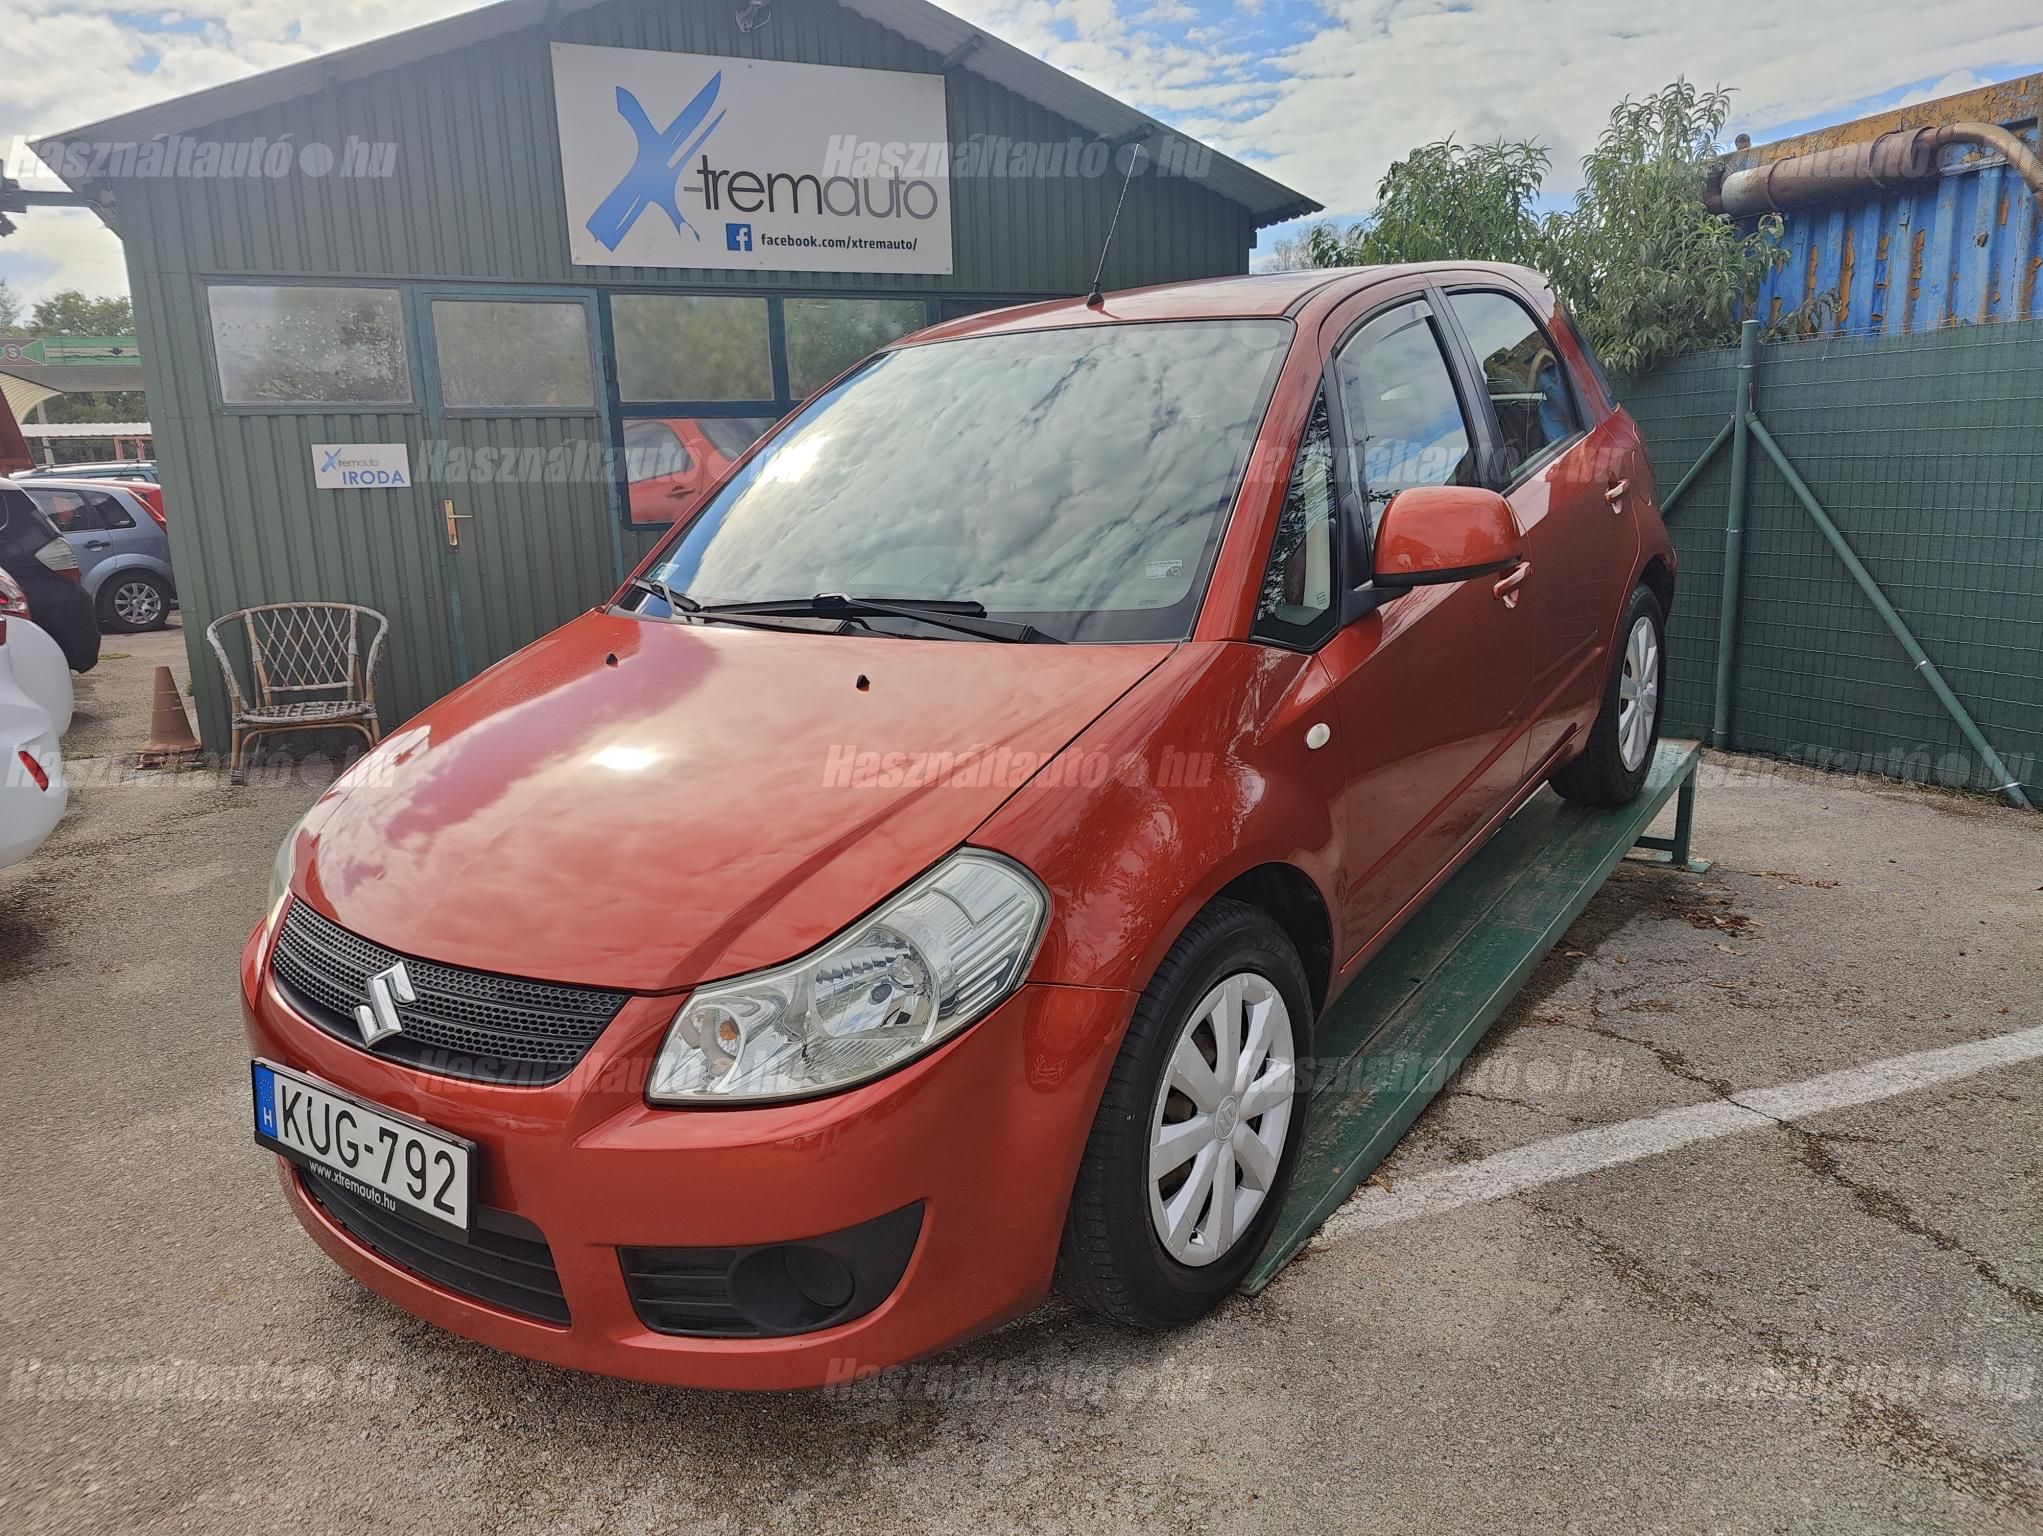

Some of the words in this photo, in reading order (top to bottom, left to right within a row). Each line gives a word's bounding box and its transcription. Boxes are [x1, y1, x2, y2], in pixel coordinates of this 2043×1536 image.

[761, 233, 918, 251] facebook.com/xtremauto/
[342, 470, 405, 485] IRODA
[263, 1107, 273, 1129] H
[281, 1085, 456, 1216] KUG-792
[308, 1159, 397, 1213] www.xtremauto.hu
